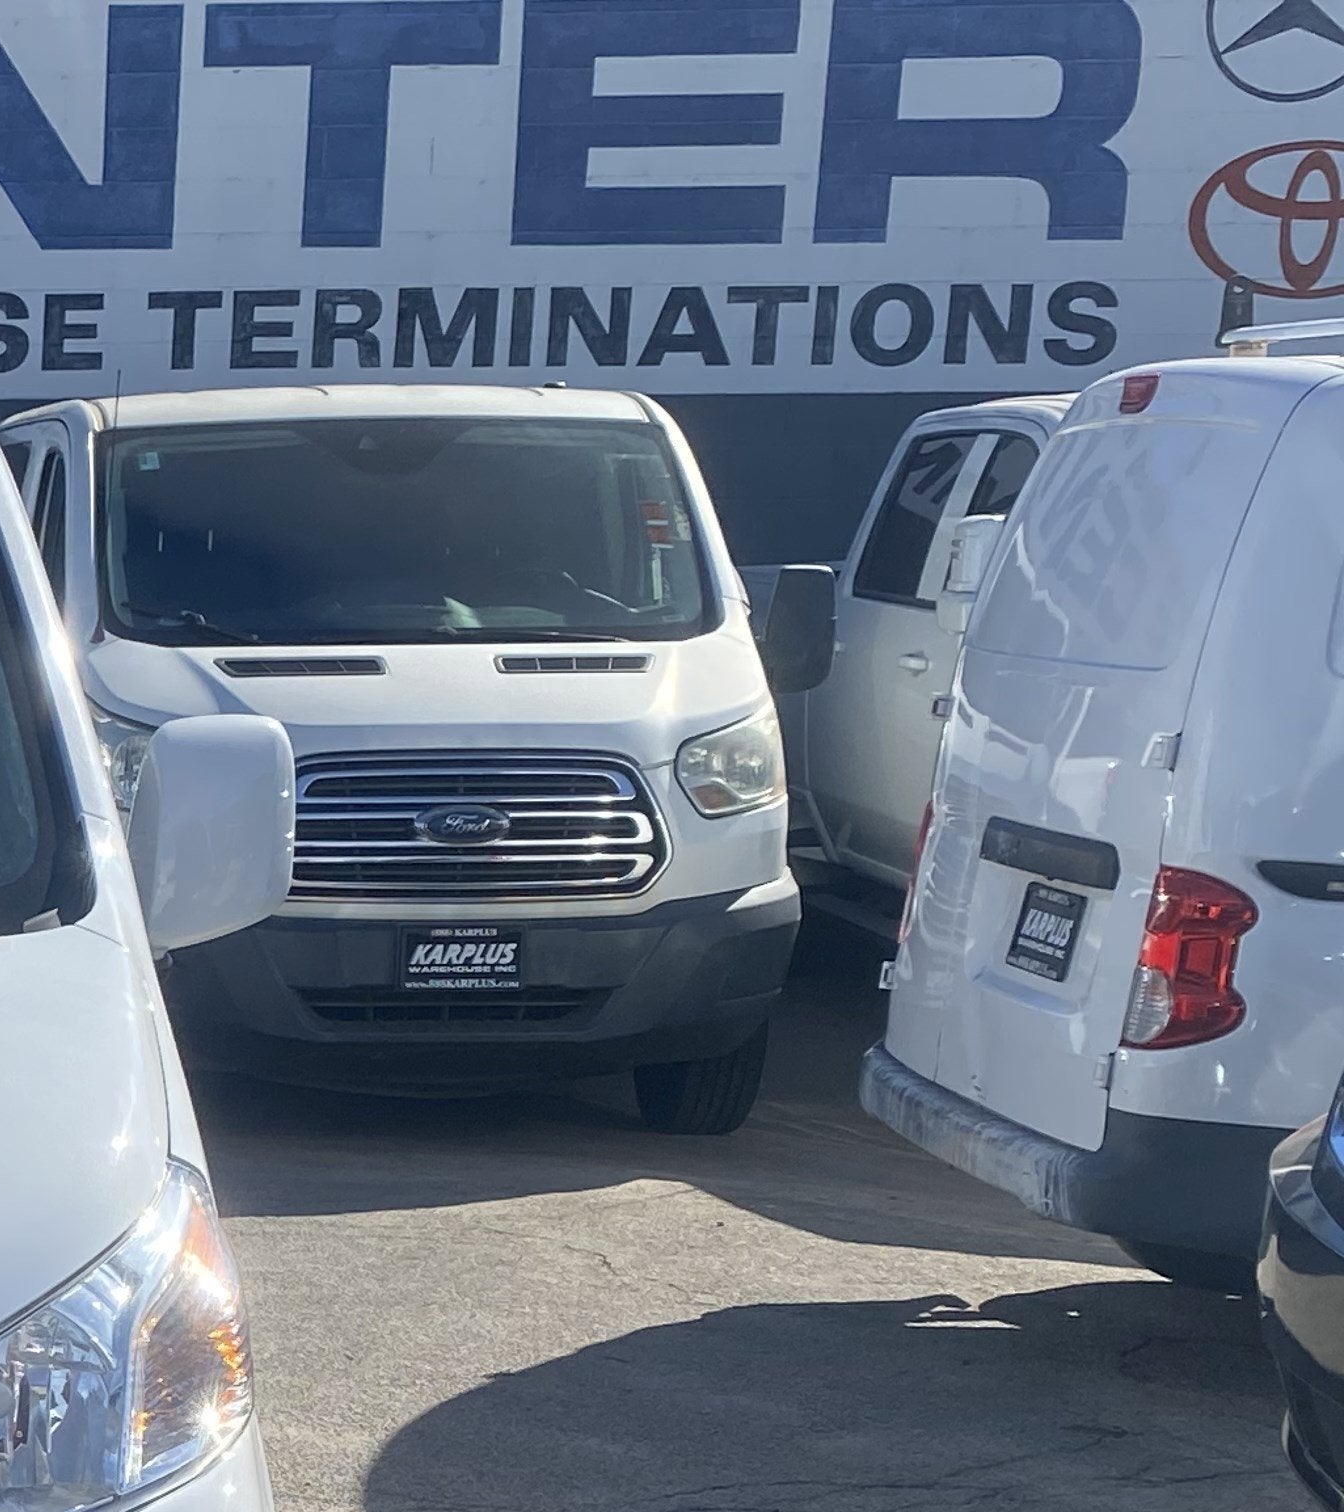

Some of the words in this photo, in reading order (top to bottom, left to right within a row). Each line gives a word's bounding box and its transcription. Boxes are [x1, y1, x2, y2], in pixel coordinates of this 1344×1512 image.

[147, 281, 1119, 371] TERMINATIONS
[440, 813, 490, 834] Ford
[1021, 908, 1075, 947] KARPLUS
[410, 943, 518, 965] KARPLUS
[408, 965, 492, 973] WAREHOUSE
